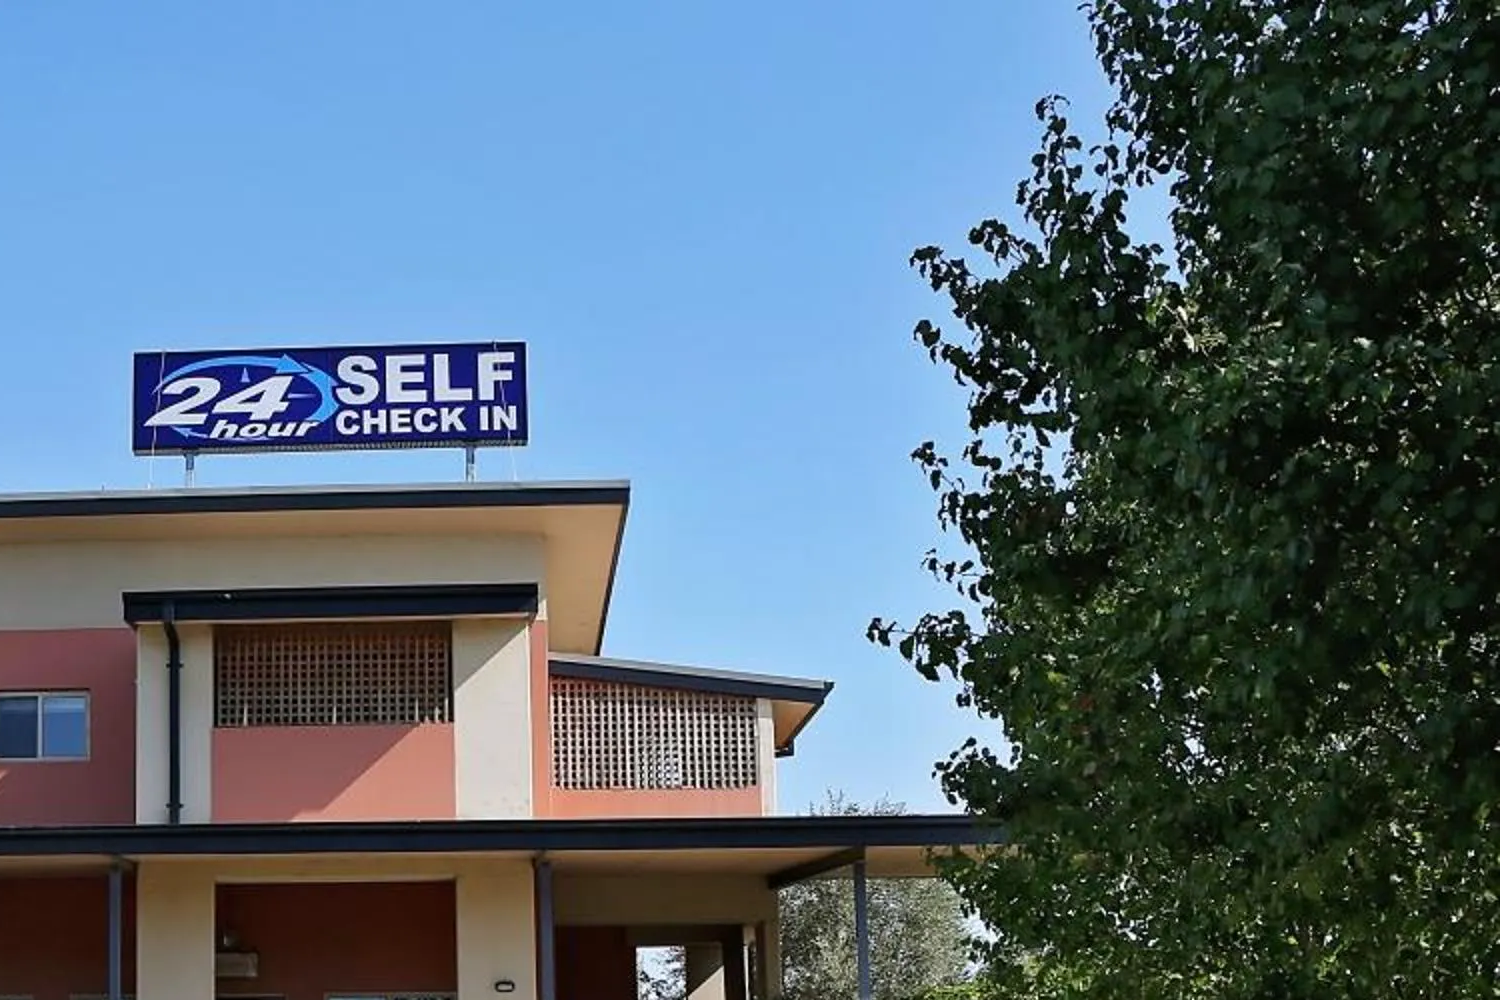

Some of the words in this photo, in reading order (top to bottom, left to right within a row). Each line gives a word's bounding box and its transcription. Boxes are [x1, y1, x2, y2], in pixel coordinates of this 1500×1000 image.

[336, 352, 515, 404] SELF
[143, 375, 293, 426] 24
[336, 408, 467, 435] CHECK
[480, 405, 517, 431] IN
[209, 418, 320, 438] hour
